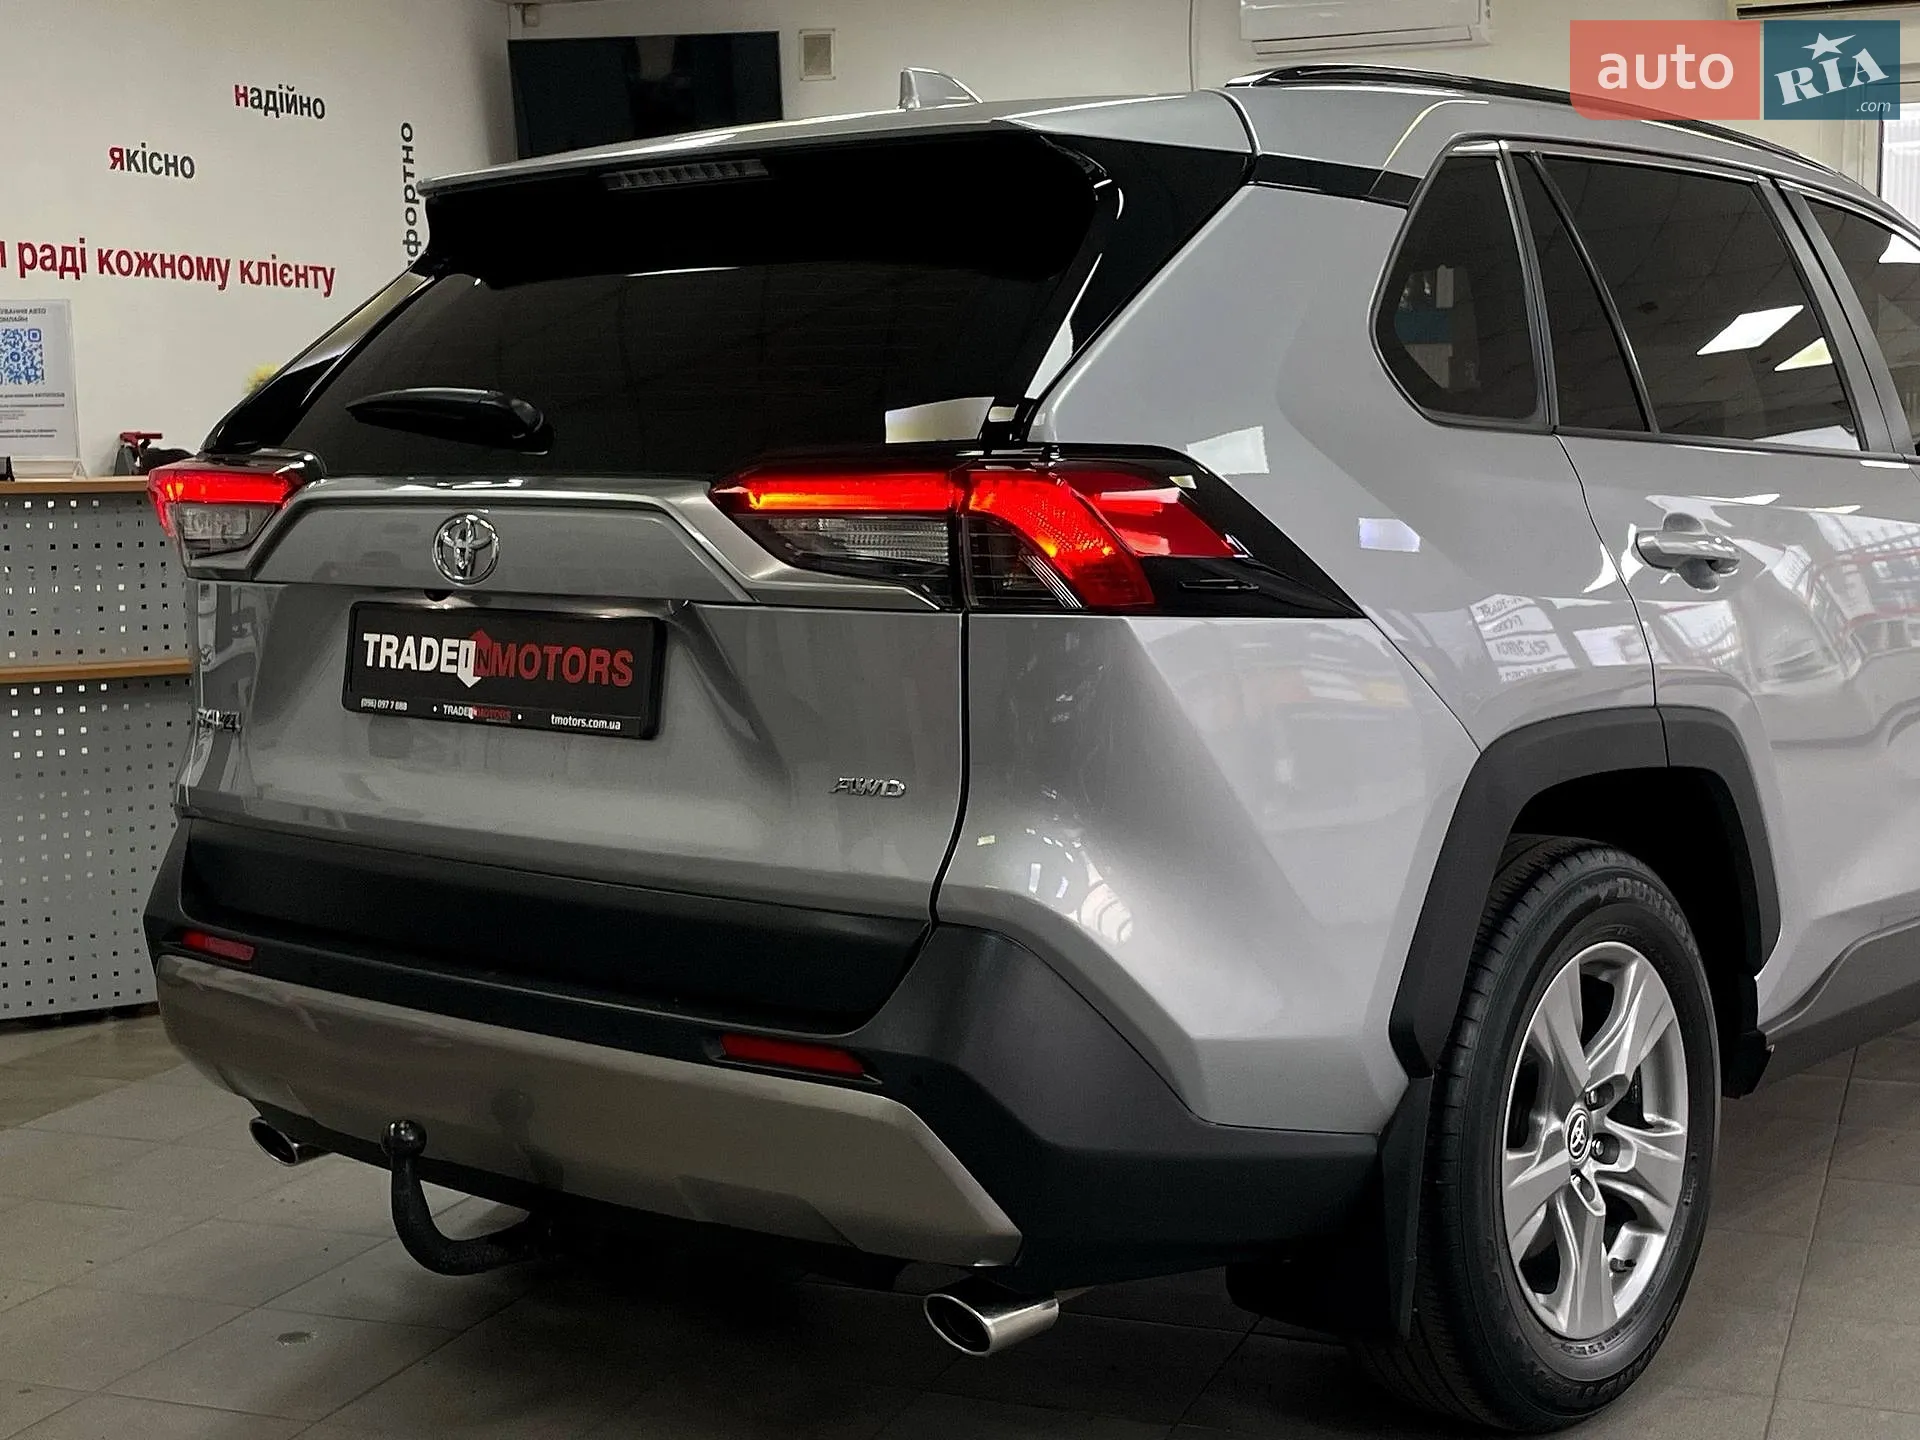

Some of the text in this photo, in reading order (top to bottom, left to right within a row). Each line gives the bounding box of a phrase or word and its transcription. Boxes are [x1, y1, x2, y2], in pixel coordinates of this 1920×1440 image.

[233, 83, 326, 119] надійно
[108, 142, 196, 179] якісно
[401, 122, 422, 267] фортно
[17, 237, 87, 280] раді
[97, 246, 231, 290] кожному
[240, 254, 336, 298] клієнту
[550, 713, 621, 731] tmotors.com.ua
[828, 777, 906, 797] AWD
